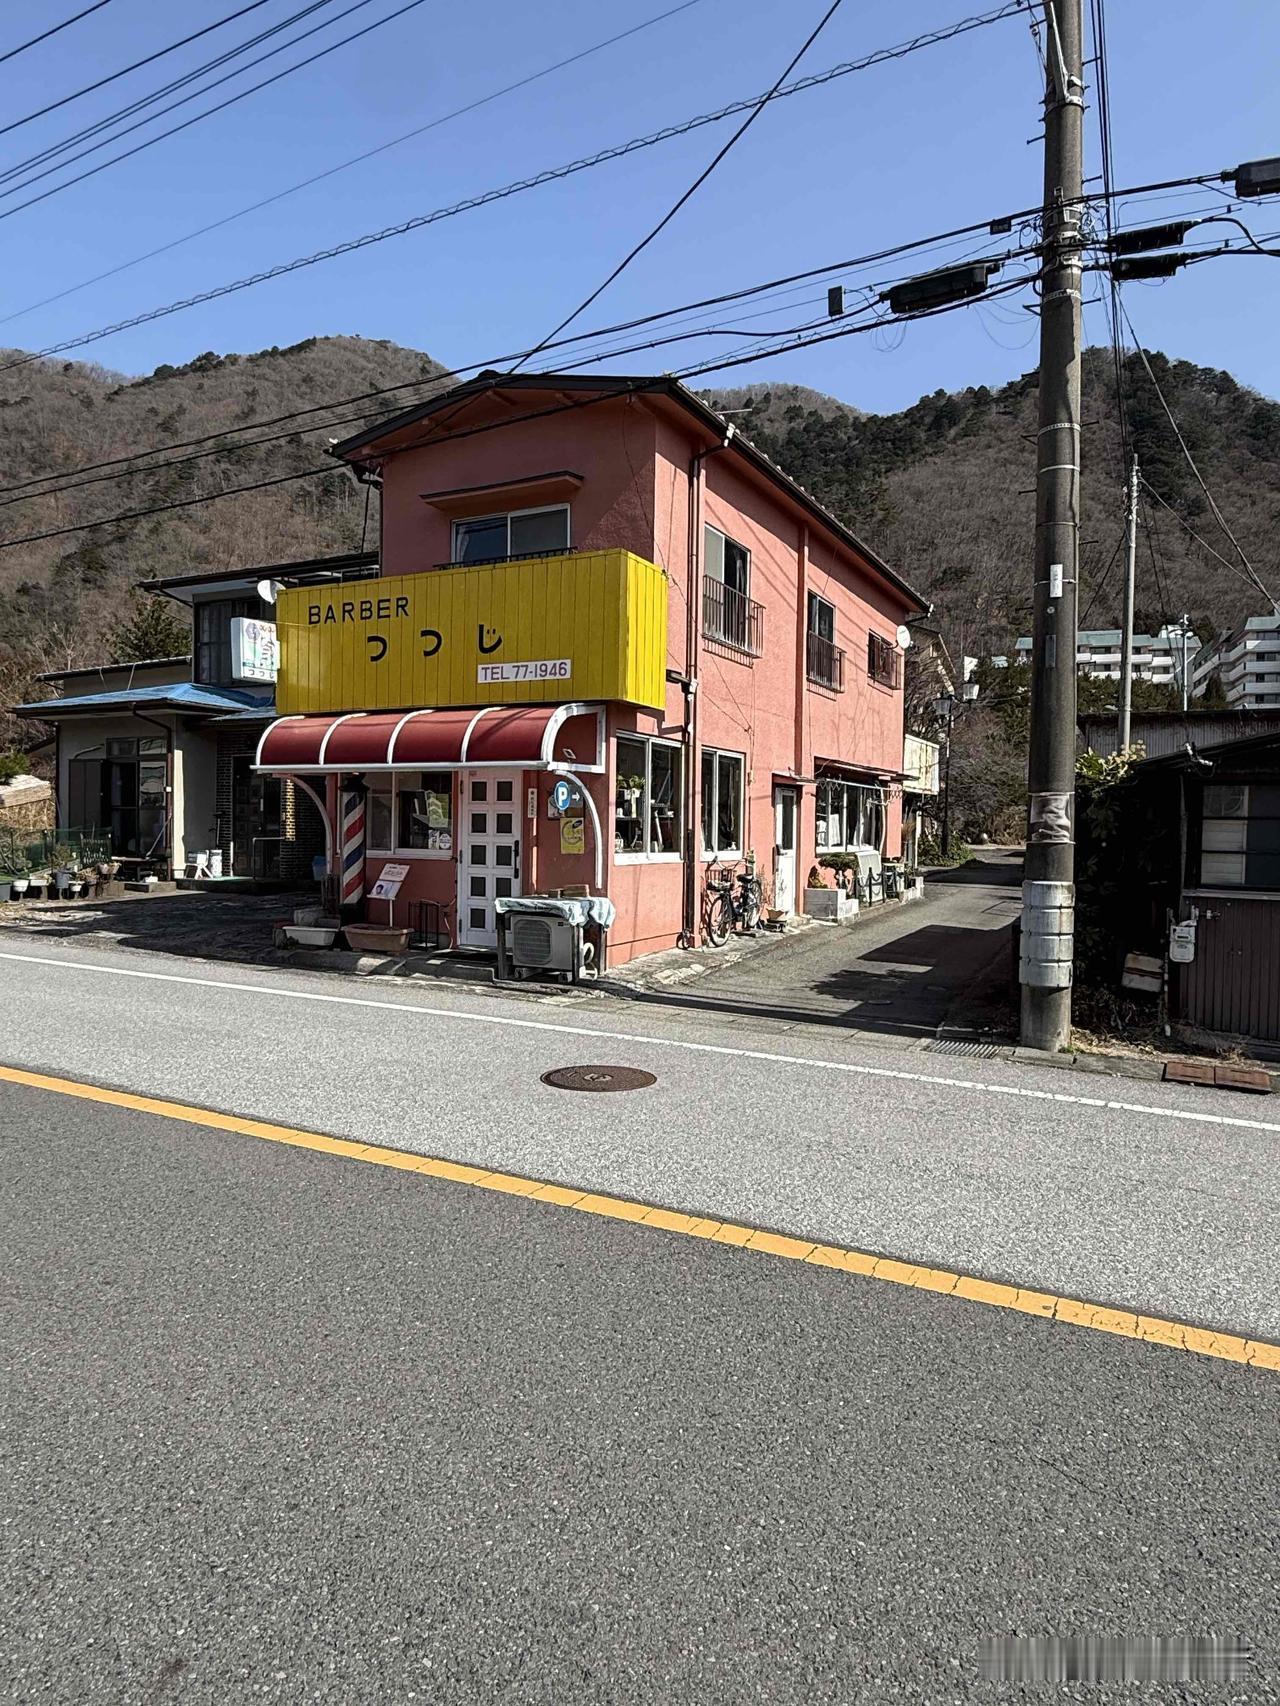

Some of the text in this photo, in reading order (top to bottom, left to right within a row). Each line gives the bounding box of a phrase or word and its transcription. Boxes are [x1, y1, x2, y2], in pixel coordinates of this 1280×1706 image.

[308, 596, 410, 625] BARBER
[367, 624, 503, 662] つつじ
[481, 661, 568, 681] TEL 77-1946
[557, 786, 568, 807] P
